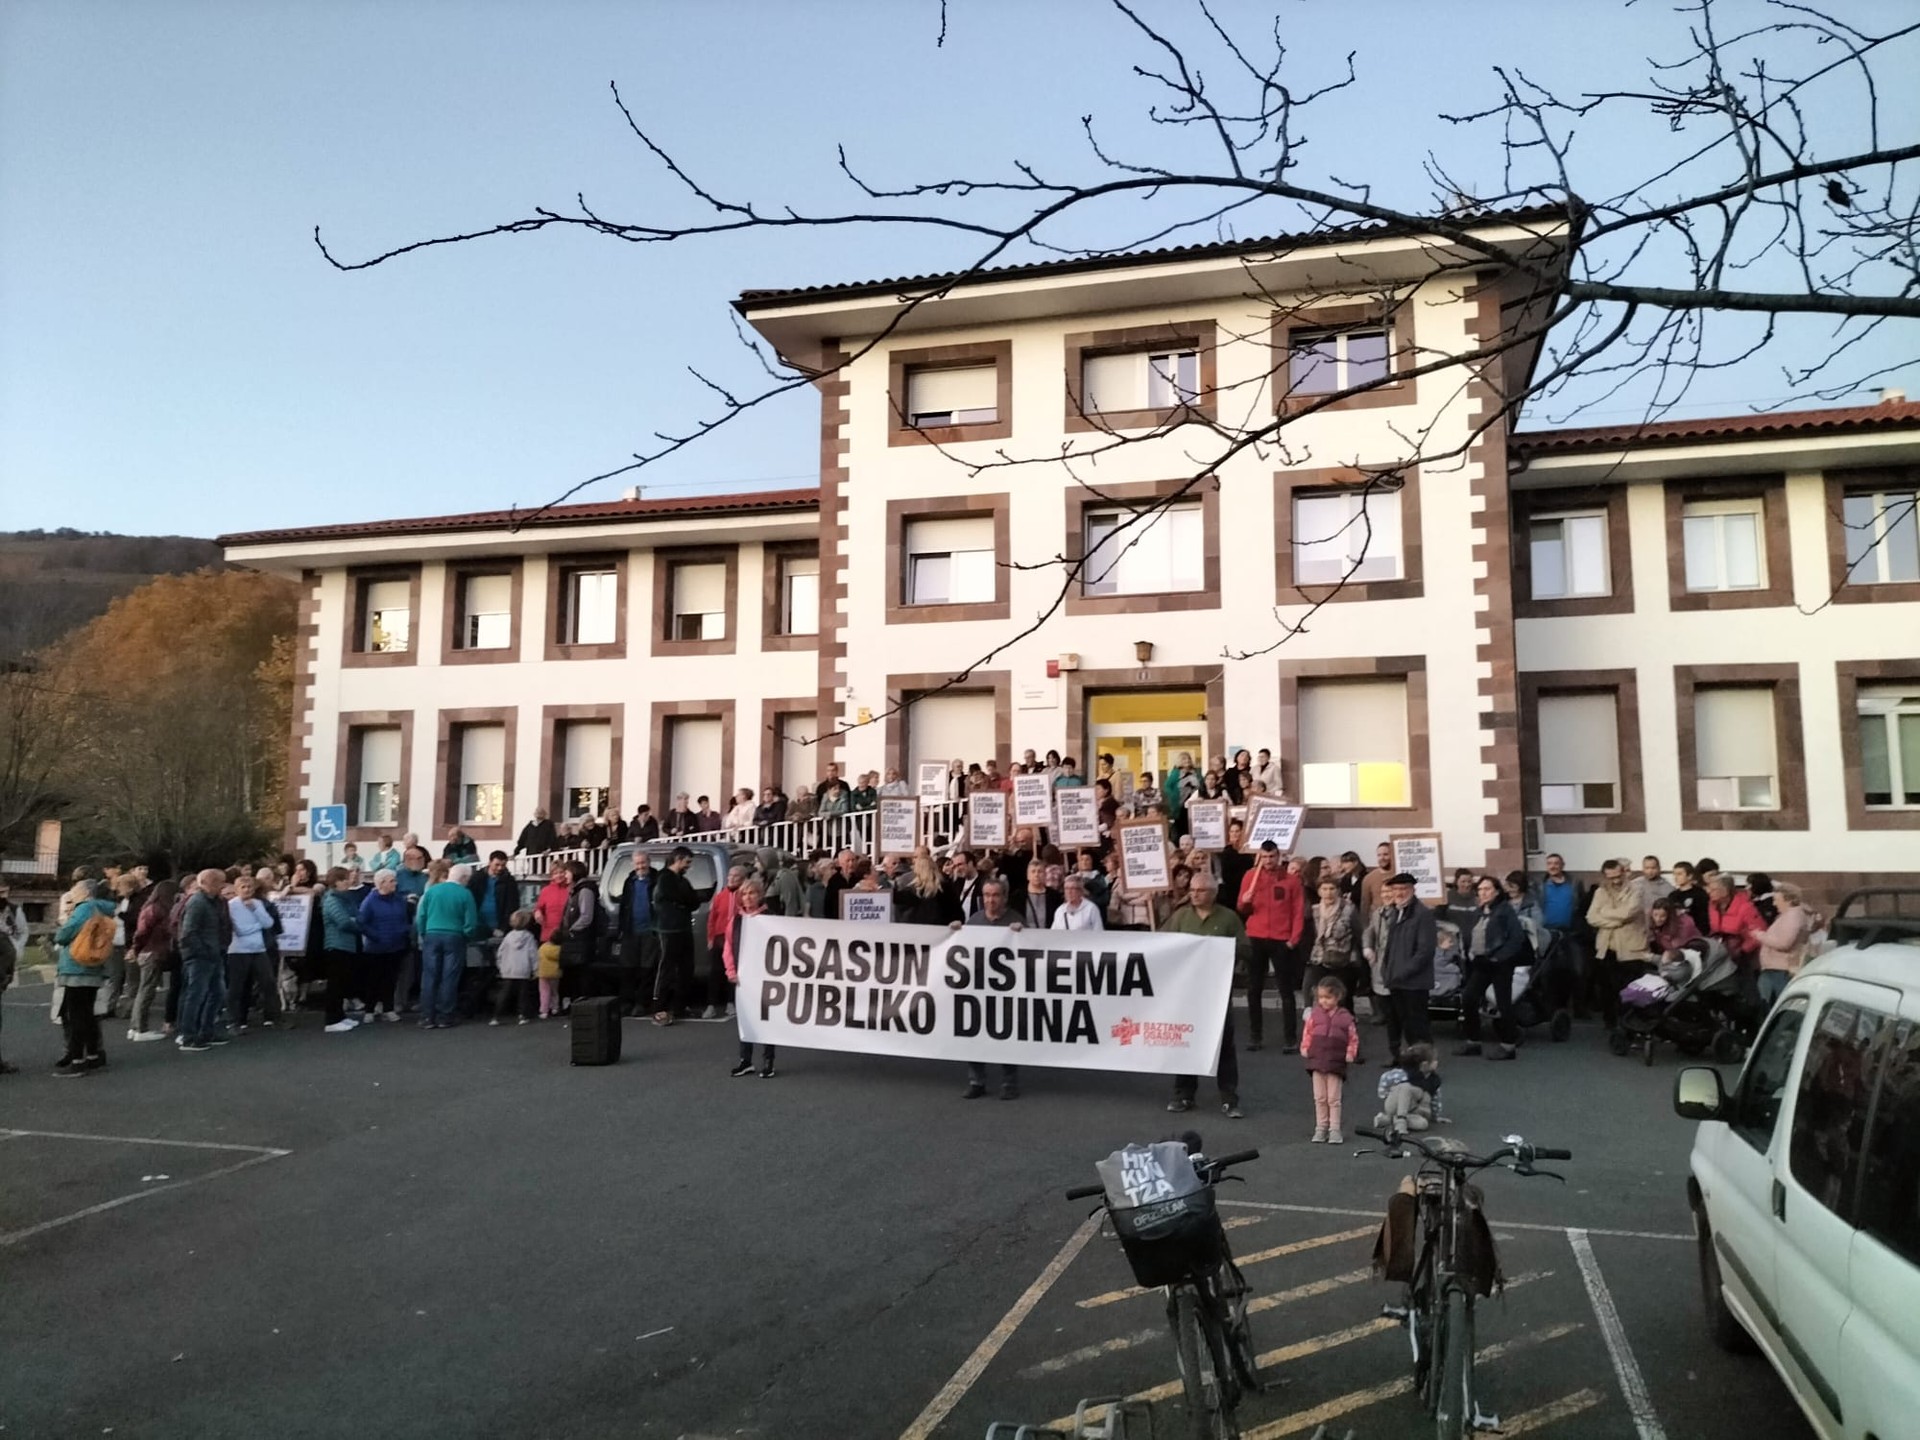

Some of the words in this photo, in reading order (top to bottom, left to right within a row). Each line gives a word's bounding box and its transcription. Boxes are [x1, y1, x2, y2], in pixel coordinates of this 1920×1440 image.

[765, 935, 930, 986] OSASUN
[944, 944, 1154, 997] SISTEMA
[760, 980, 936, 1036] PUBLIKO
[953, 994, 1100, 1045] DUINA
[1143, 1022, 1194, 1033] BAZTANGO
[1143, 1031, 1182, 1041] OSASUN
[1121, 1161, 1166, 1189] KUN
[1124, 1180, 1175, 1208] TZA
